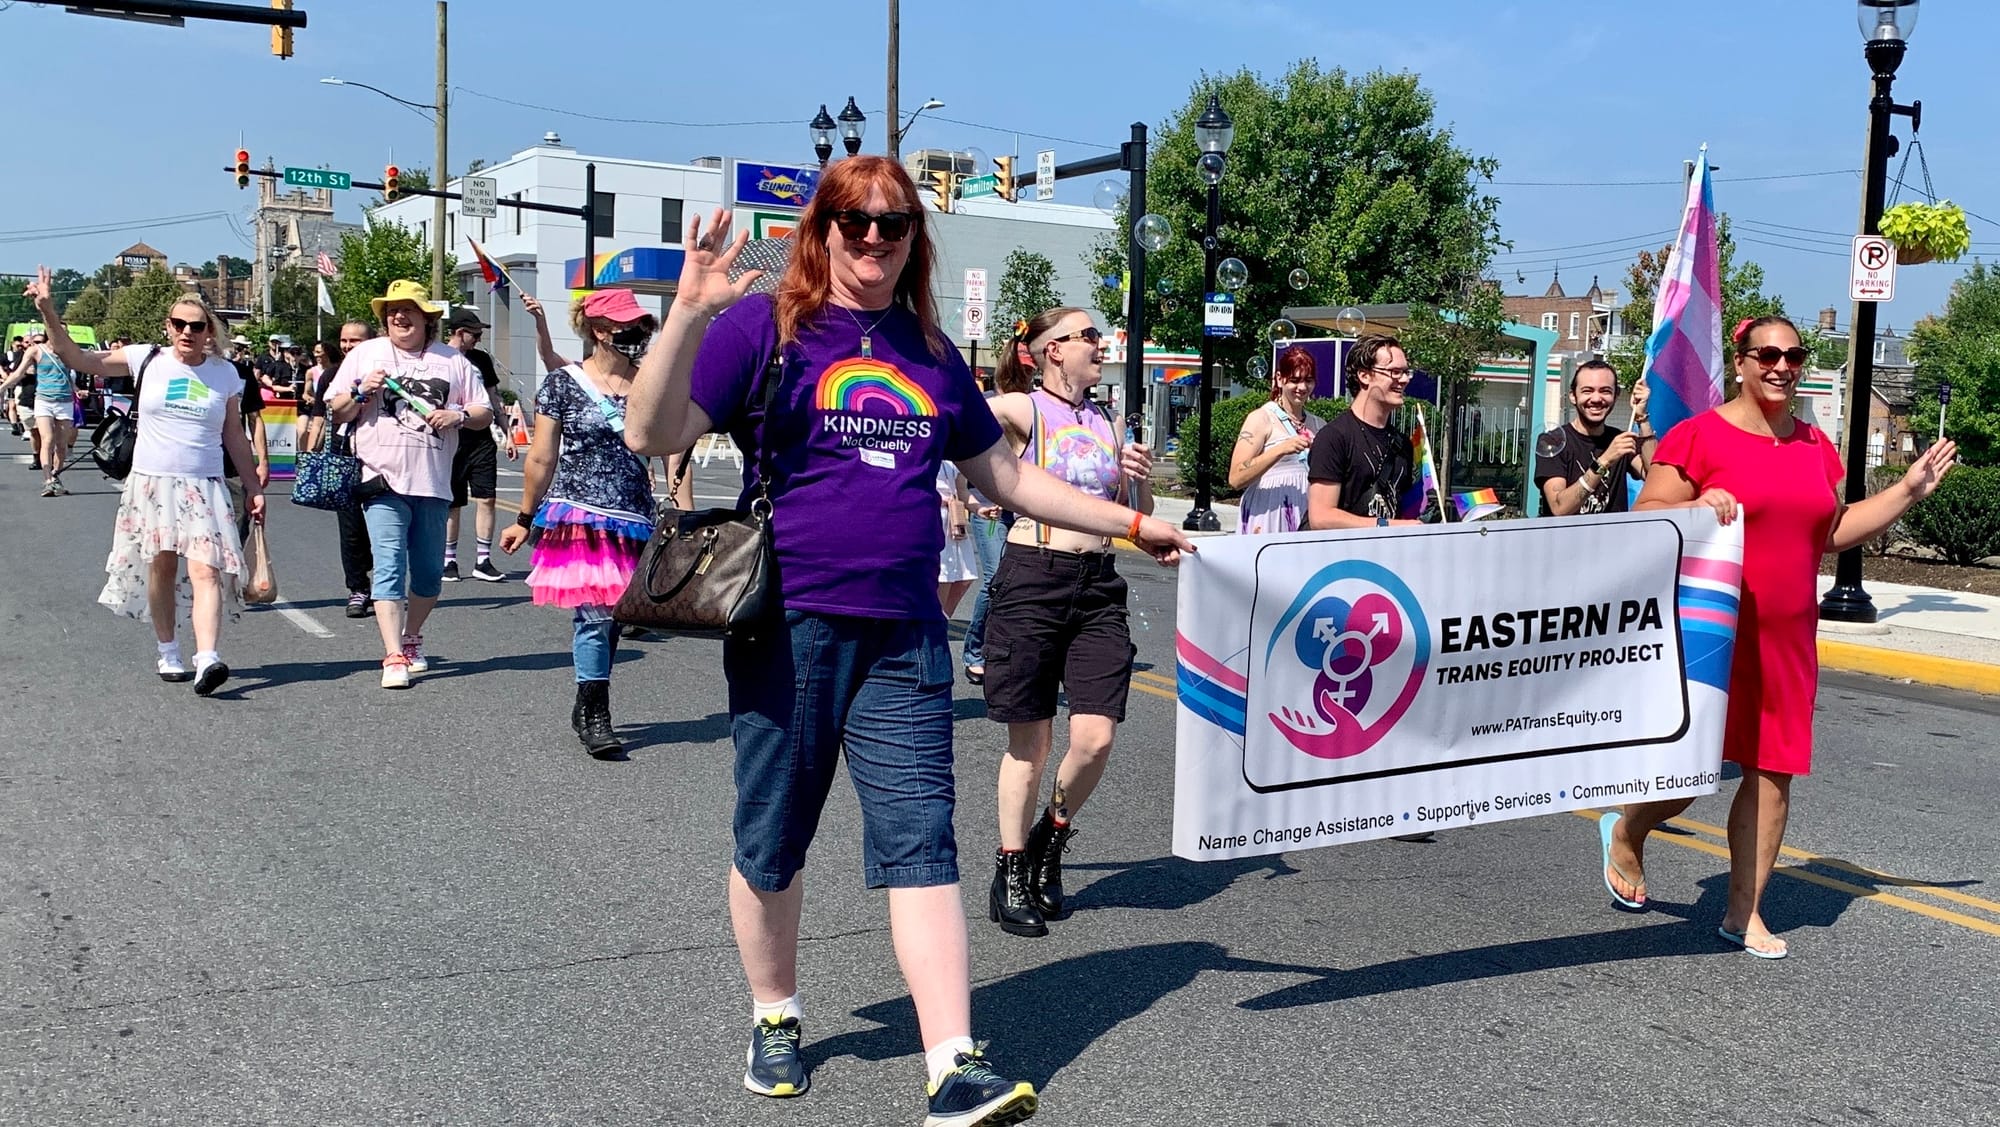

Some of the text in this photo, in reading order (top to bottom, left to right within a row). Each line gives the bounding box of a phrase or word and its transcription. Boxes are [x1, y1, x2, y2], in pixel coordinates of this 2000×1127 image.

[290, 170, 345, 186] 12th St
[473, 180, 486, 188] NO
[469, 188, 490, 197] TURN
[761, 181, 806, 194] SUNOCO
[965, 180, 994, 194] Hamilton
[464, 196, 494, 206] ON RED
[1867, 271, 1879, 279] NO
[393, 282, 401, 291] P
[1855, 279, 1890, 288] PARKING
[824, 414, 931, 438] KINDNESS
[842, 435, 912, 453] Not Cruelty
[1440, 597, 1664, 654] EASTERN PA
[1436, 643, 1664, 686] TRANS EQUITY PROJECT
[1471, 709, 1622, 737] www.PATransEquity.org
[1199, 771, 1720, 850] Name Change Assistance Supportive Services Community Education
